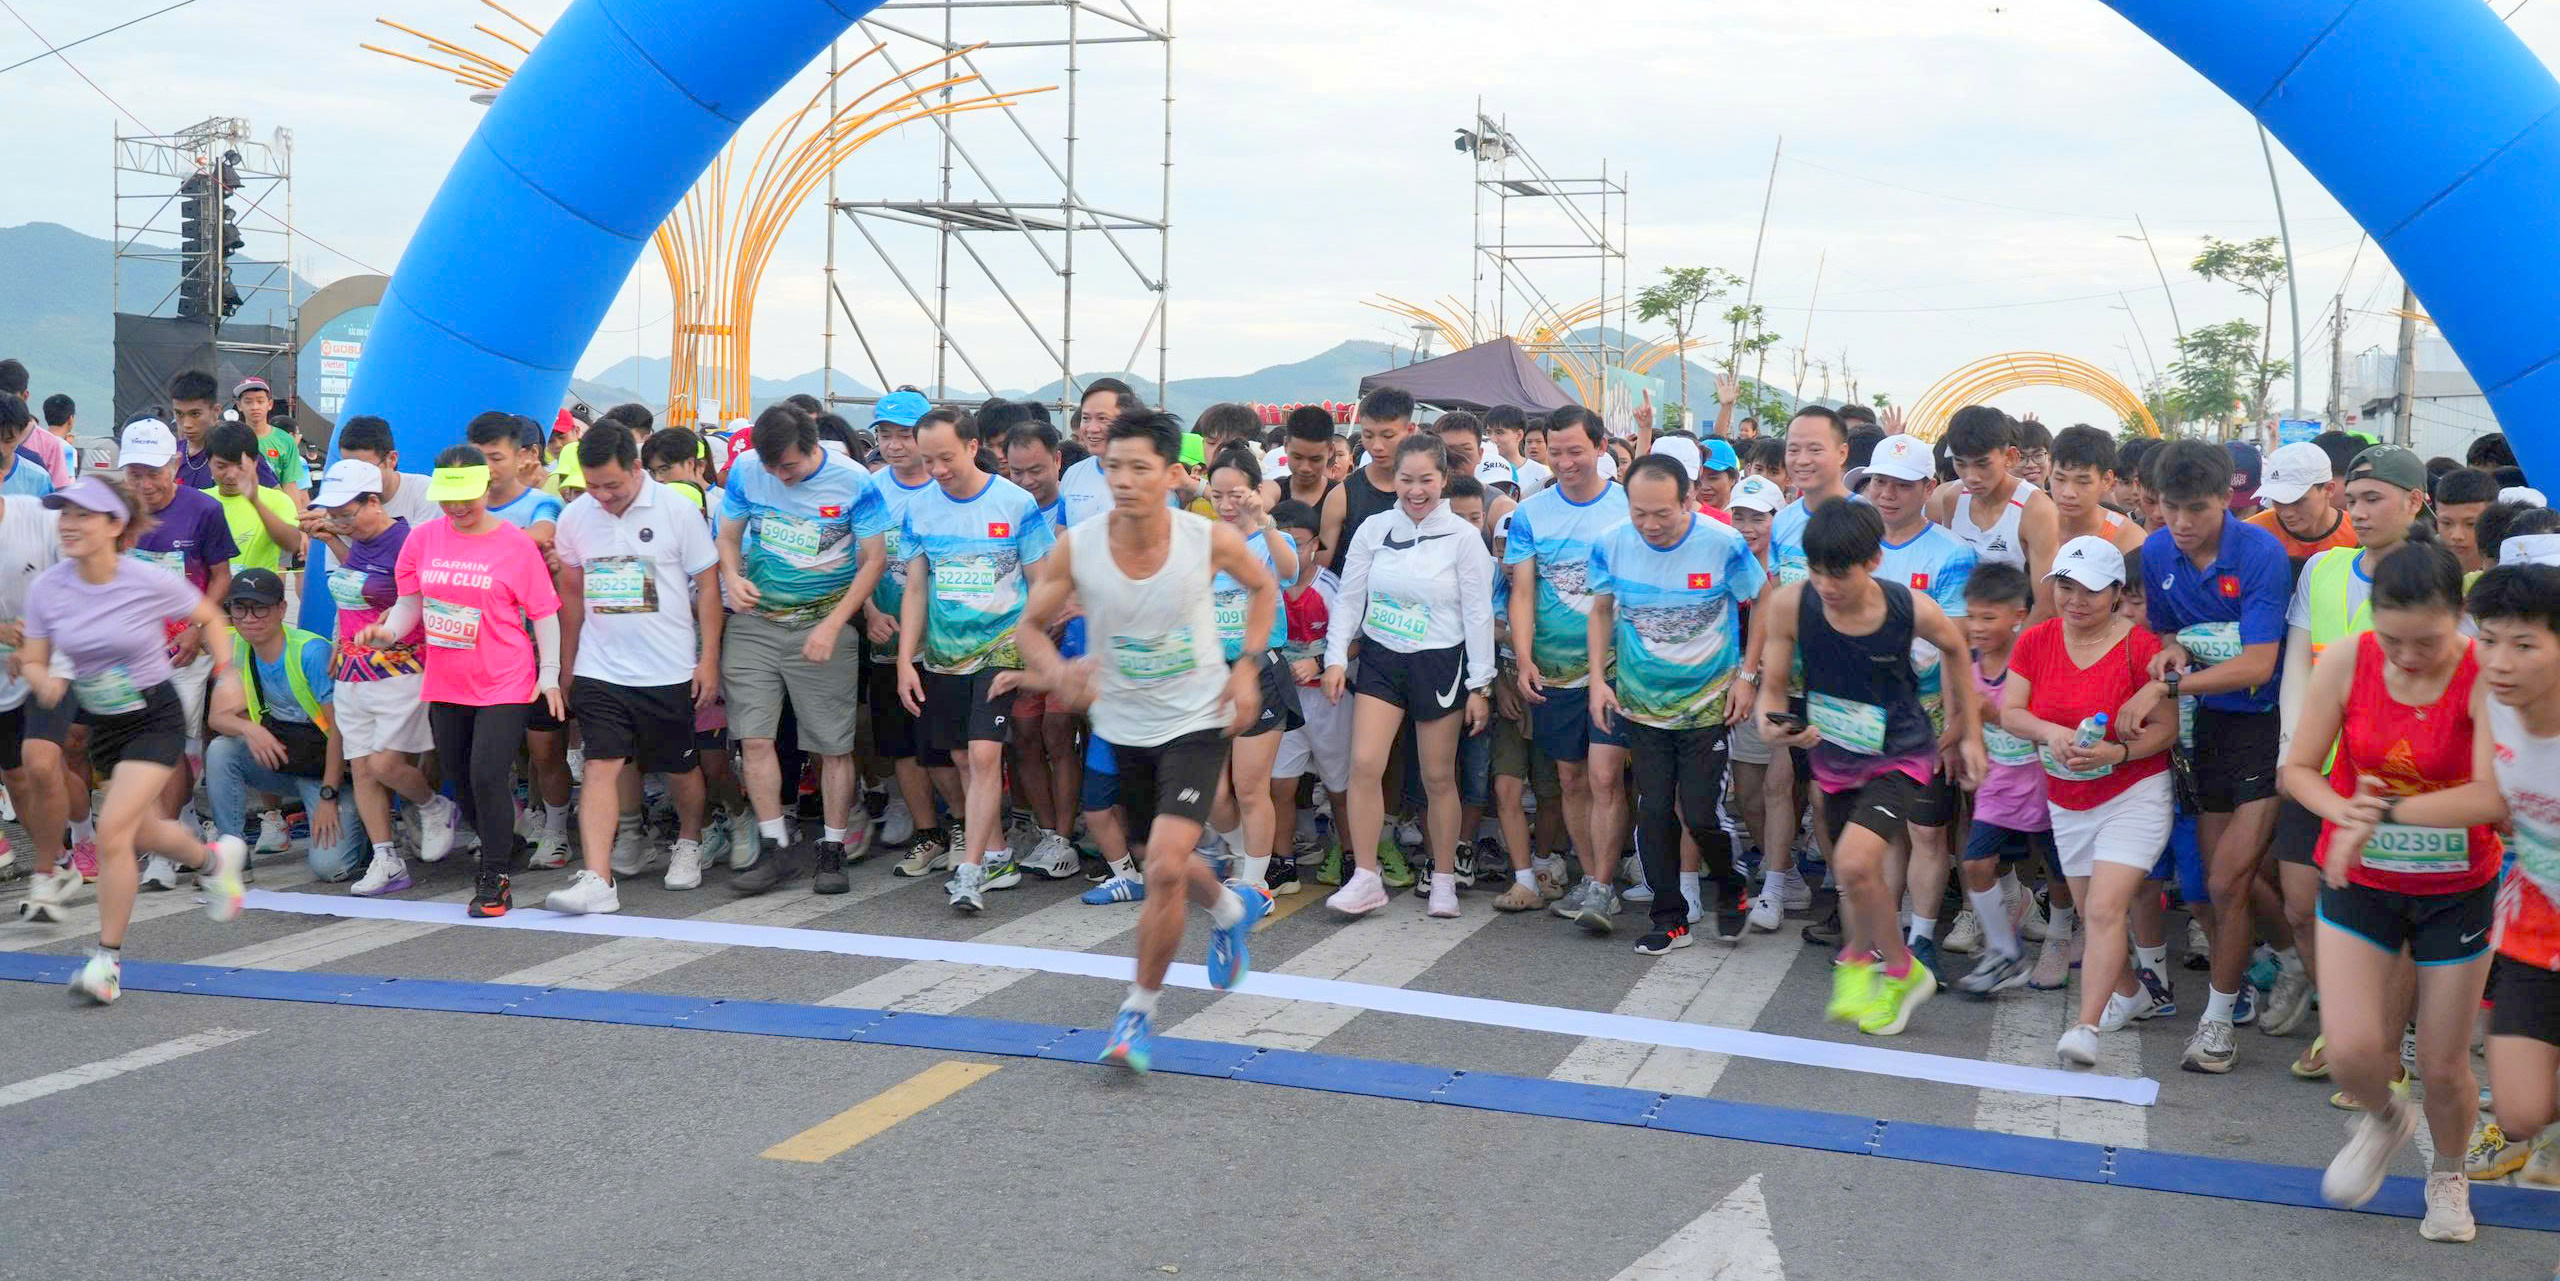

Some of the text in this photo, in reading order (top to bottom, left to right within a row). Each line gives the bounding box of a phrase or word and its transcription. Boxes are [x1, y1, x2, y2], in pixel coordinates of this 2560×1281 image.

[764, 523, 806, 546] 59036
[431, 558, 489, 572] GARMIN
[422, 569, 493, 590] RUN CLUB
[938, 571, 980, 585] 52222
[1371, 606, 1413, 630] 58014
